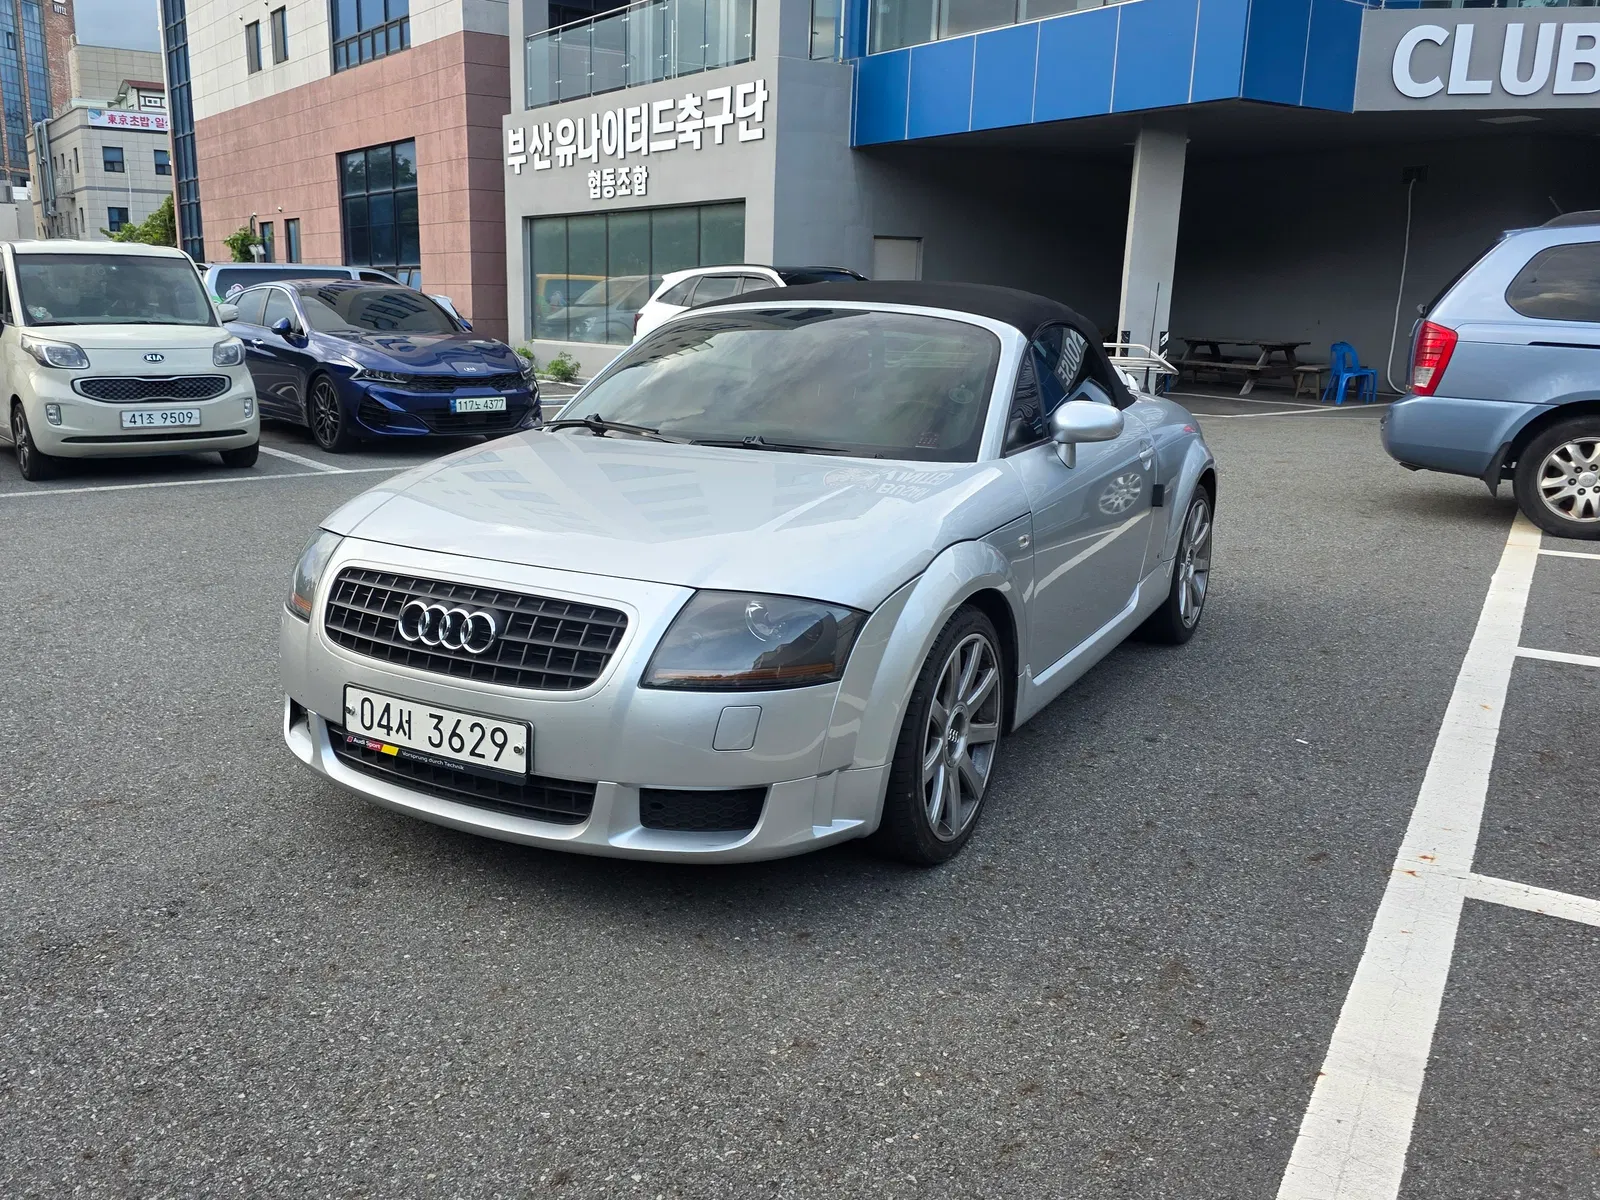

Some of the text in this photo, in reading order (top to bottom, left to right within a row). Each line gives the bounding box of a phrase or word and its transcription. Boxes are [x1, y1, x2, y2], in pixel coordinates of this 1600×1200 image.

[1392, 23, 1600, 98] CLUB
[587, 165, 648, 199] 협동조합
[129, 411, 193, 425] 41조 9509
[483, 399, 504, 410] 4377
[360, 696, 508, 762] 04서 3629
[352, 737, 465, 770] Audi Sport Vorsprung durch Technik
